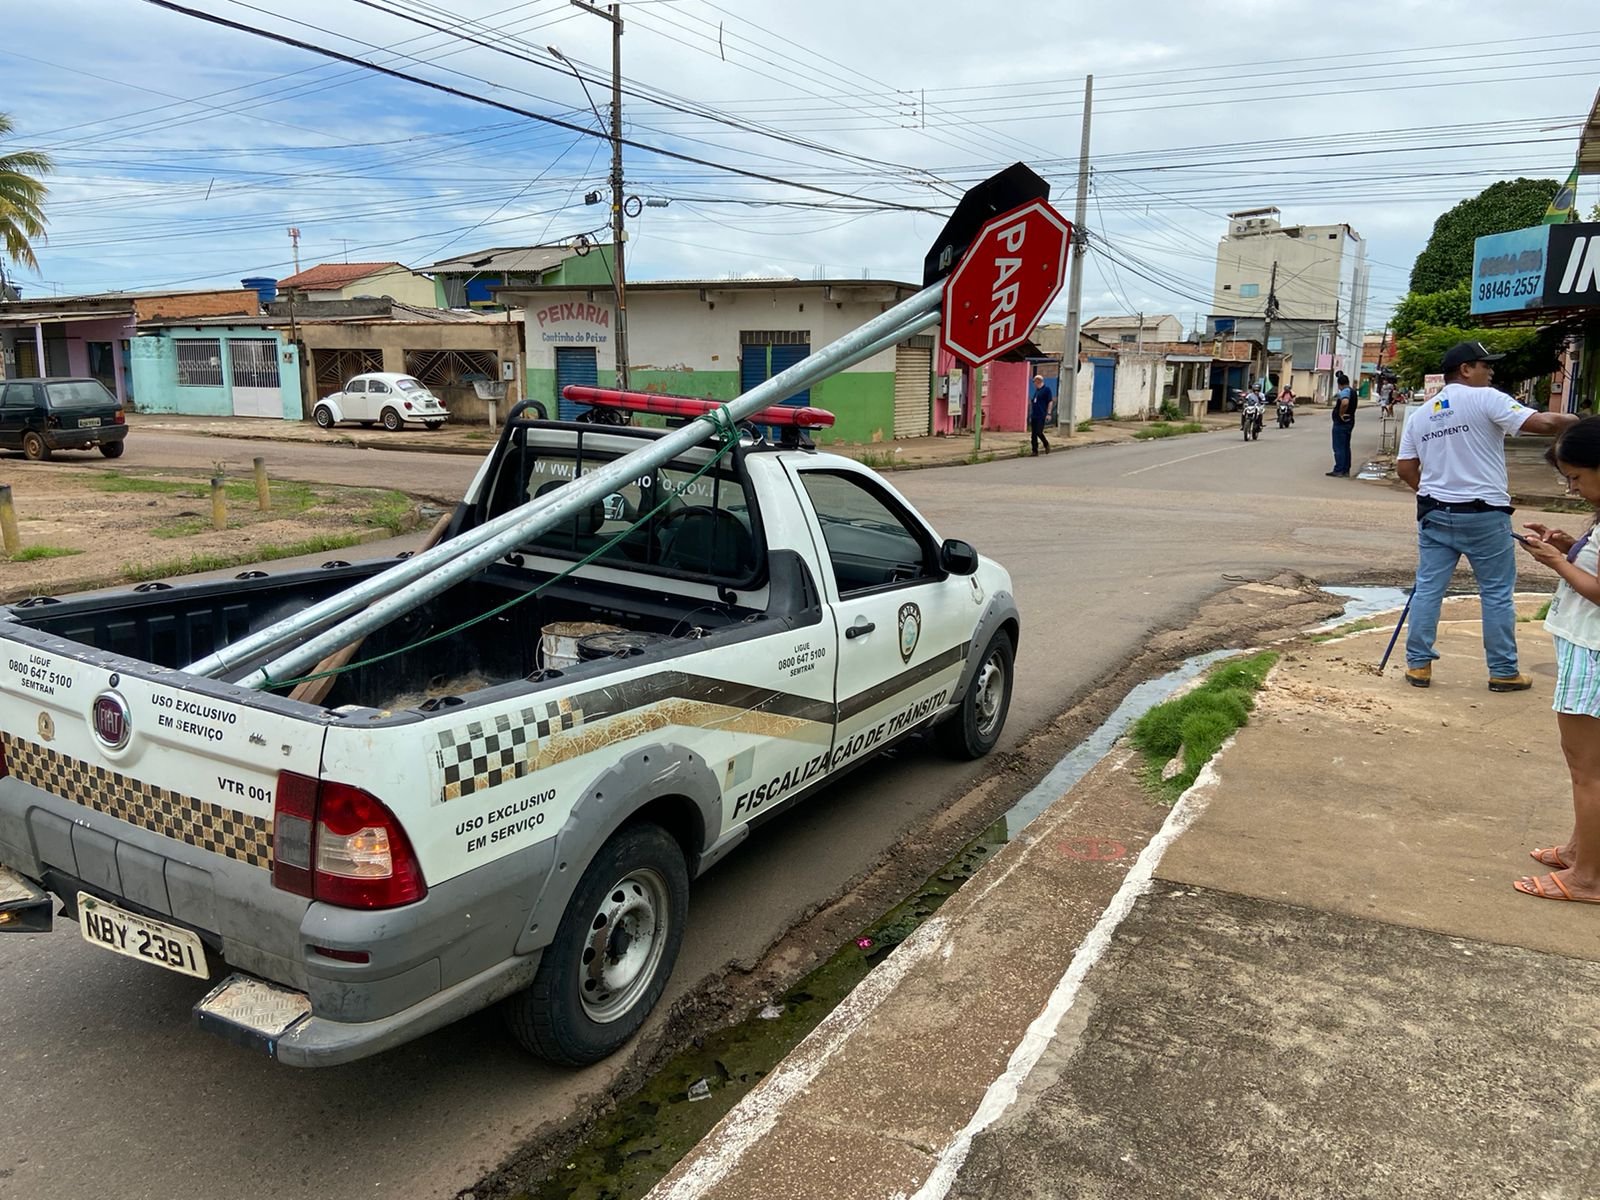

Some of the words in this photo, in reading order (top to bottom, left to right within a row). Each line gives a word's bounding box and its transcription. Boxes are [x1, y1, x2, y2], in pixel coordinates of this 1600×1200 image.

[987, 221, 1027, 349] PARE
[1479, 275, 1541, 301] 98146-2557
[537, 302, 609, 328] PEIXARIA
[778, 657, 796, 671] 0800
[796, 653, 809, 665] 647
[810, 647, 826, 661] 5100
[794, 642, 810, 653] LIGUE
[9, 659, 29, 675] 0800
[30, 666, 47, 681] 647
[49, 672, 72, 689] 5100
[790, 663, 815, 677] SEMTRAN
[21, 677, 55, 696] SEMTRAN
[101, 708, 120, 735] FIAT
[151, 693, 173, 708] USO
[175, 699, 237, 725] EXCLUSIVO
[158, 714, 174, 729] EM
[175, 720, 223, 741] SERVIÇO
[732, 734, 864, 820] FISCALIZAÇÃO
[865, 726, 884, 749] DE
[887, 689, 948, 735] TRÂNSITO
[217, 776, 245, 796] VTR
[248, 786, 272, 803] 001
[455, 816, 484, 836] USO
[488, 788, 556, 825] EXCLUSIVO
[467, 835, 487, 853] EM
[490, 812, 545, 843] SERVIÇO
[85, 911, 127, 949] NBY
[137, 928, 197, 972] 2391
